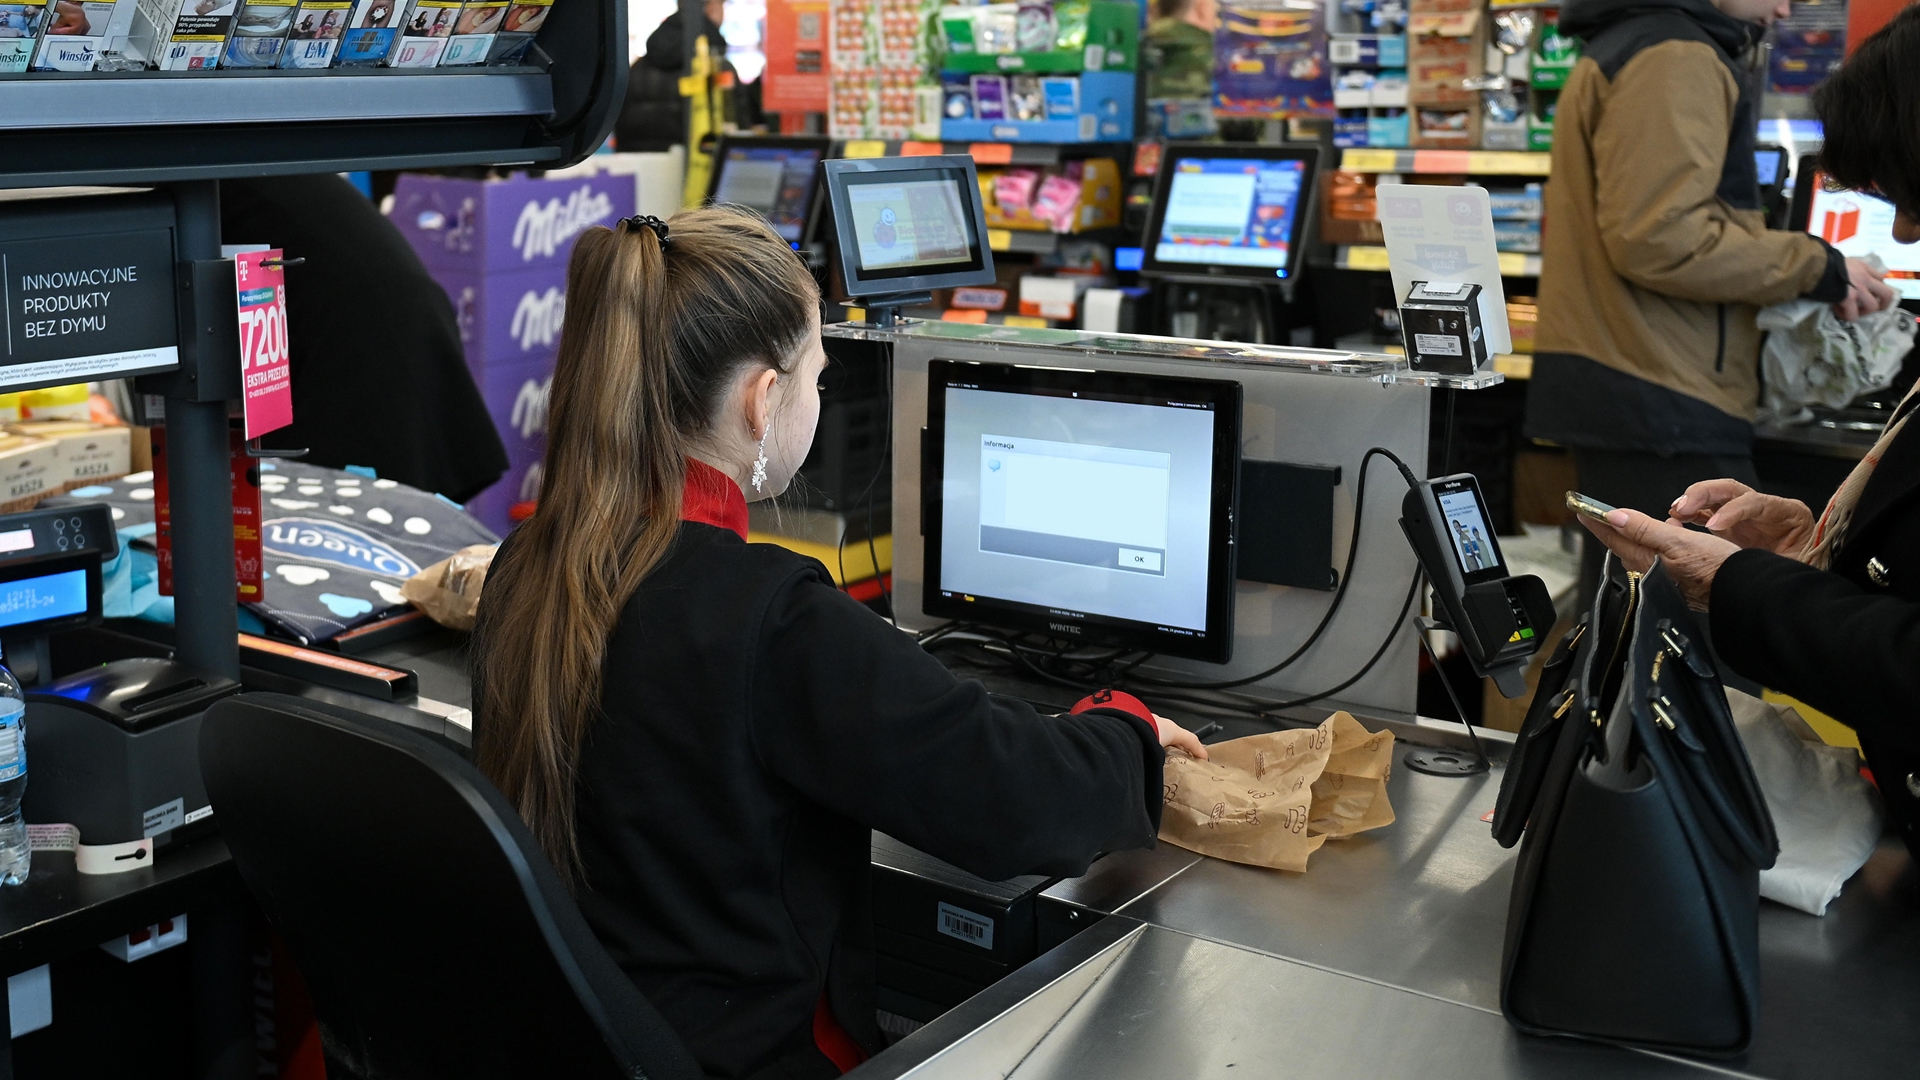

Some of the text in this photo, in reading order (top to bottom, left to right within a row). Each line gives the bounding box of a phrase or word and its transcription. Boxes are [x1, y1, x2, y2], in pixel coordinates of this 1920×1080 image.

[0, 52, 26, 63] inston
[59, 48, 94, 63] Winston
[304, 41, 330, 59] L&M
[512, 184, 613, 262] Milka
[22, 266, 137, 291] INNOWACYJNE
[24, 292, 111, 315] PRODUKTY
[25, 315, 107, 339] BEZ DYMU
[239, 304, 289, 370] 7200
[247, 371, 268, 388] EKSTRA
[267, 366, 282, 382] PRZEZ
[984, 440, 1015, 450] Informacja
[74, 463, 109, 476] KASZA
[271, 525, 410, 577] Queen
[0, 595, 55, 613] 024-12-24
[1049, 622, 1081, 634] WINTEC
